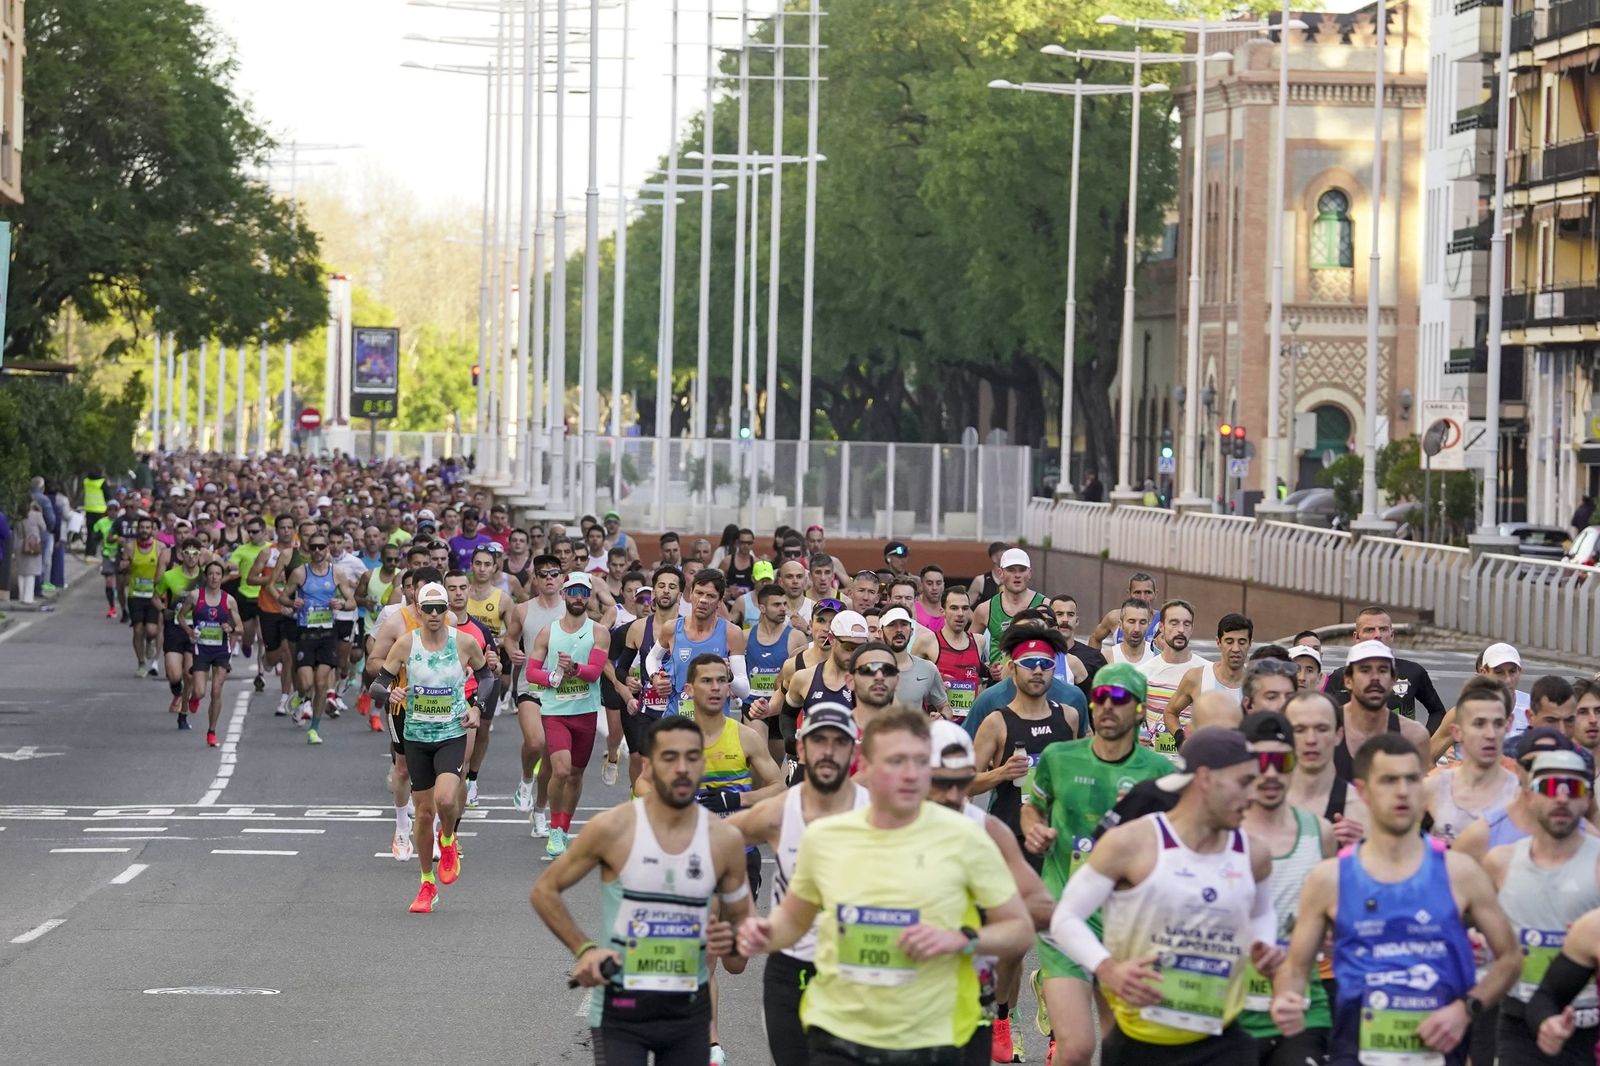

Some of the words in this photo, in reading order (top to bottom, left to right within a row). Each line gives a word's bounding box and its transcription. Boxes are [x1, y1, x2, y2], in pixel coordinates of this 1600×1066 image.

[556, 683, 590, 693] VALENTINO
[414, 704, 451, 713] BEJARANO
[861, 910, 912, 924] ZURICH
[654, 925, 695, 937] ZURICH
[859, 949, 891, 965] FOD
[637, 959, 688, 974] MIGUEL
[1179, 959, 1223, 974] ZURICH
[1391, 996, 1438, 1008] ZURICH
